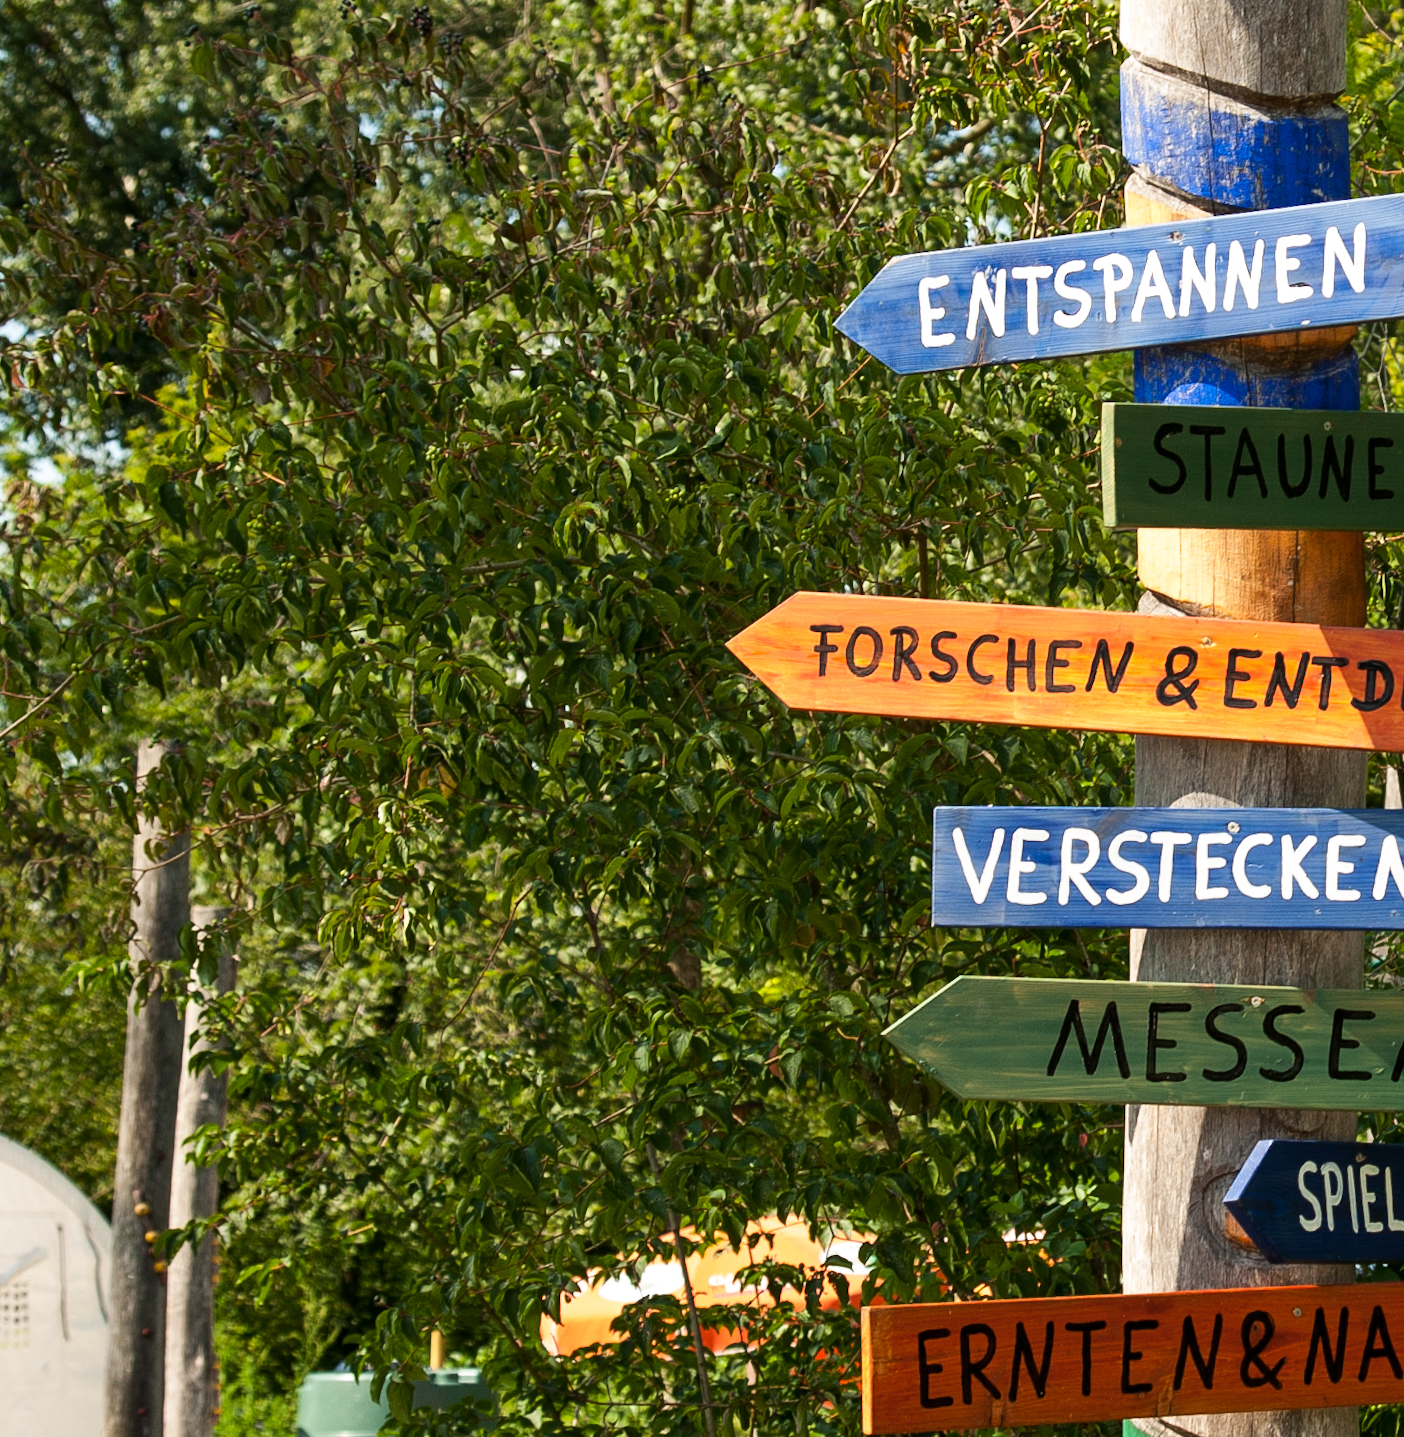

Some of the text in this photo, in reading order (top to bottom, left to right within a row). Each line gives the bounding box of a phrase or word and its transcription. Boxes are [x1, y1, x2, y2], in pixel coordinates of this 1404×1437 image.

[918, 221, 1368, 348] ENTSPANNEN
[810, 623, 1134, 693] FORSCHEN
[1155, 645, 1200, 710] &
